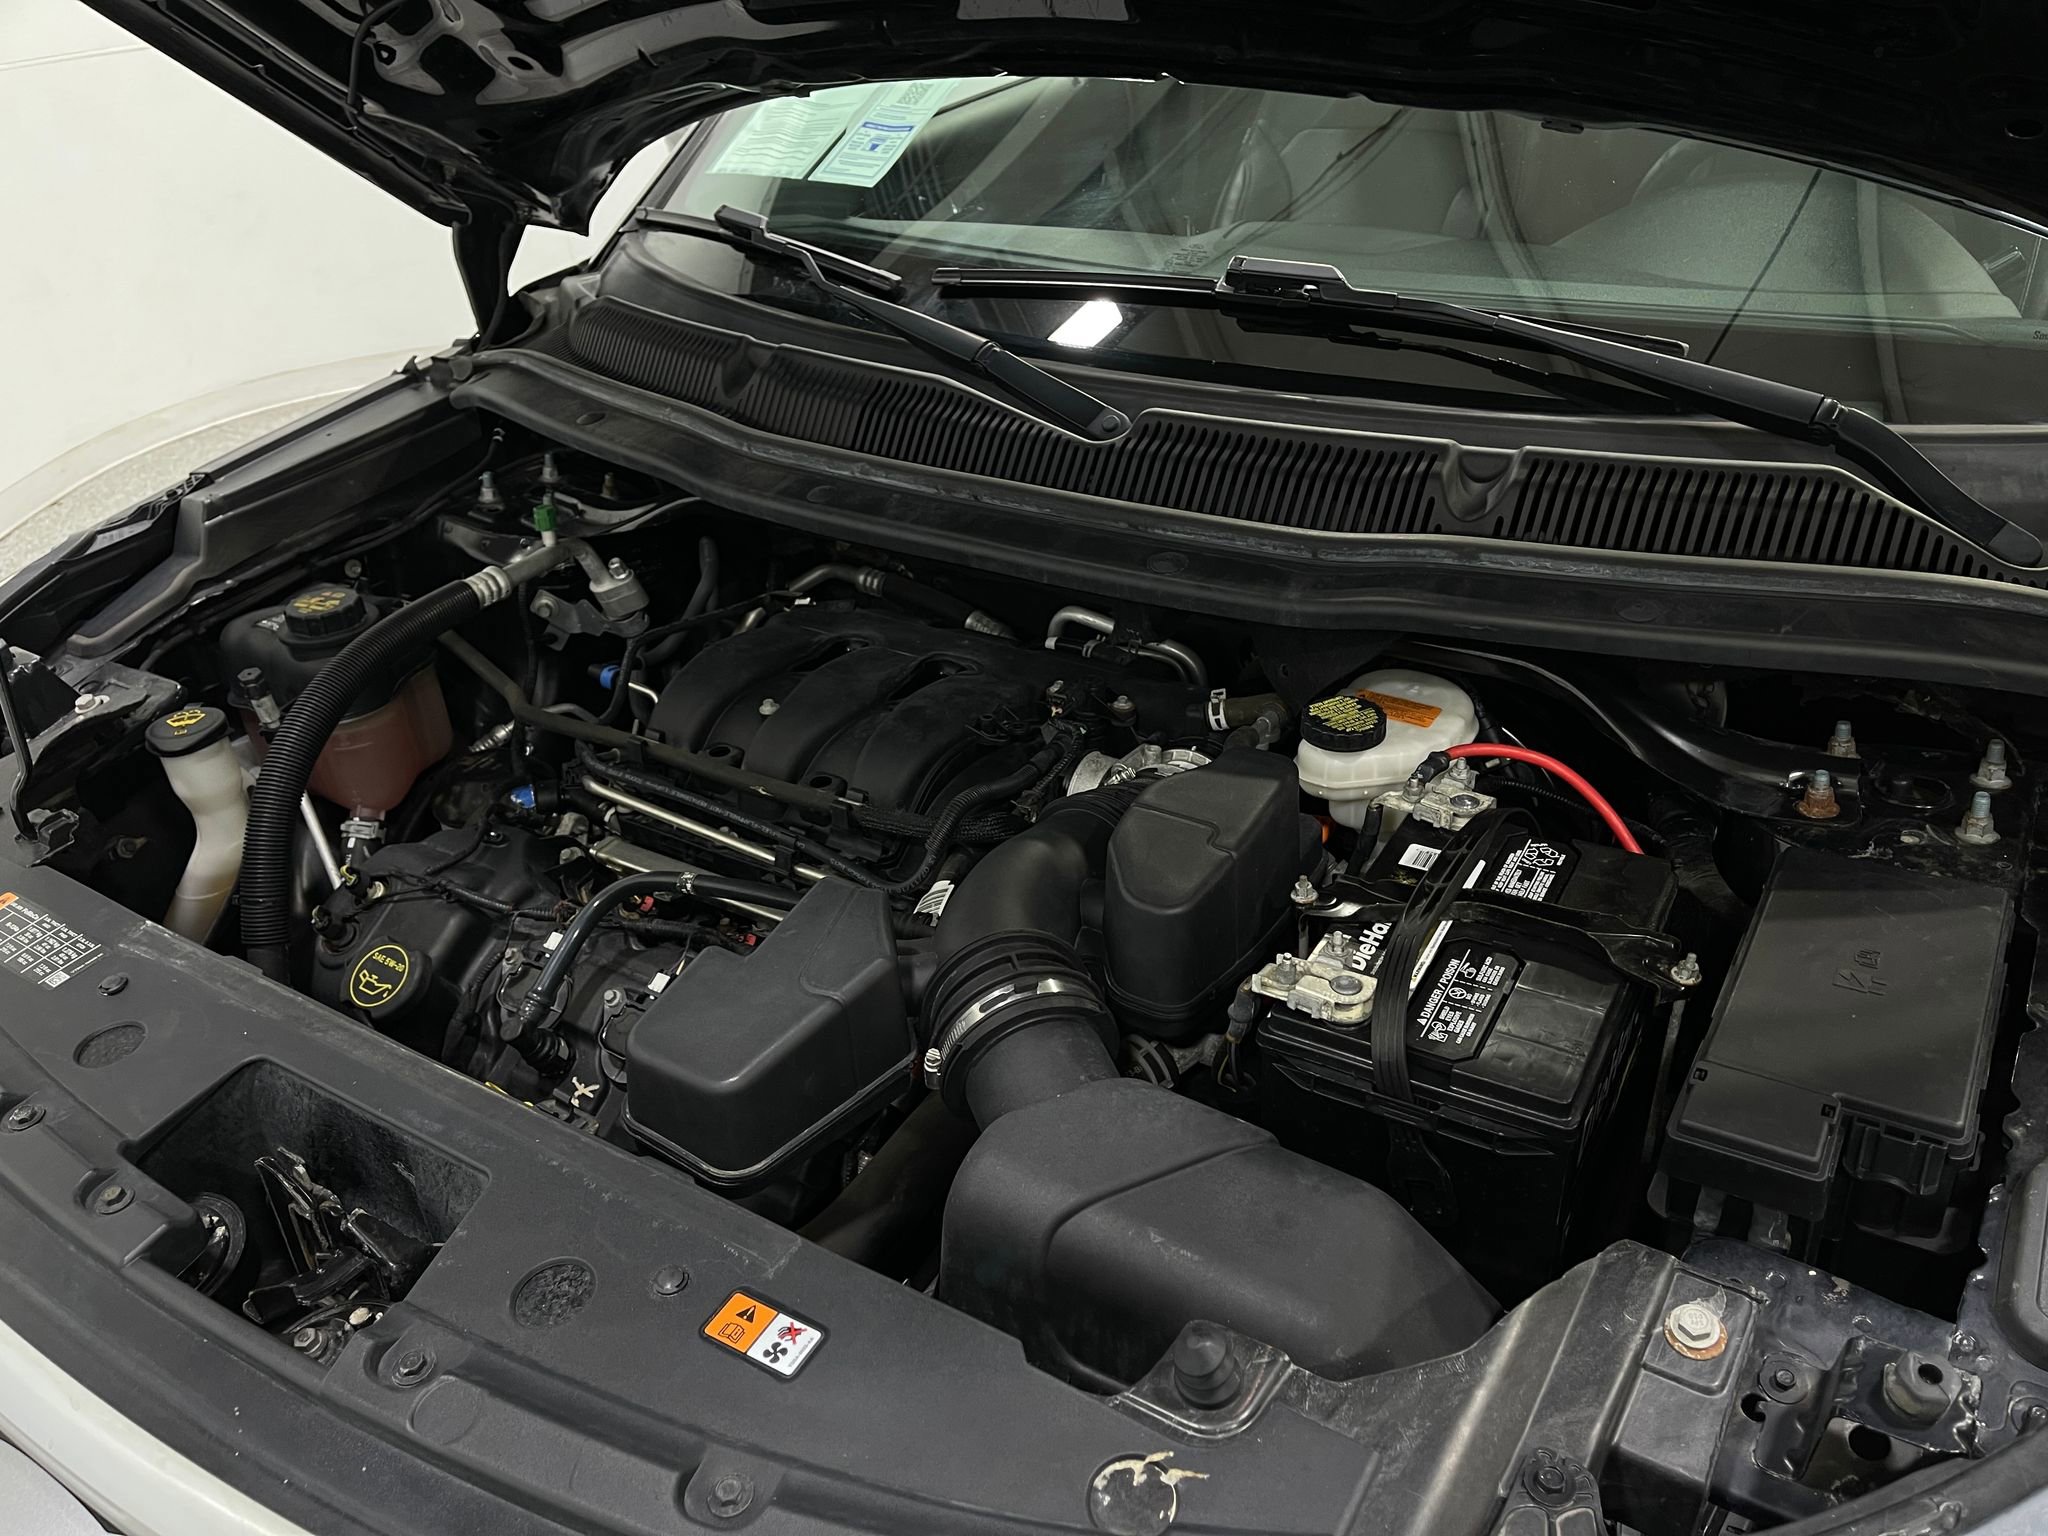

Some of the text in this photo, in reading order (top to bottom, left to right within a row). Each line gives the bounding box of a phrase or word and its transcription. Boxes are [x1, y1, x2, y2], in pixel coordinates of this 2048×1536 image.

[373, 952, 405, 972] SAE 5W-20
[1420, 988, 1444, 1016] DANGER
[1439, 958, 1461, 985] POISON
